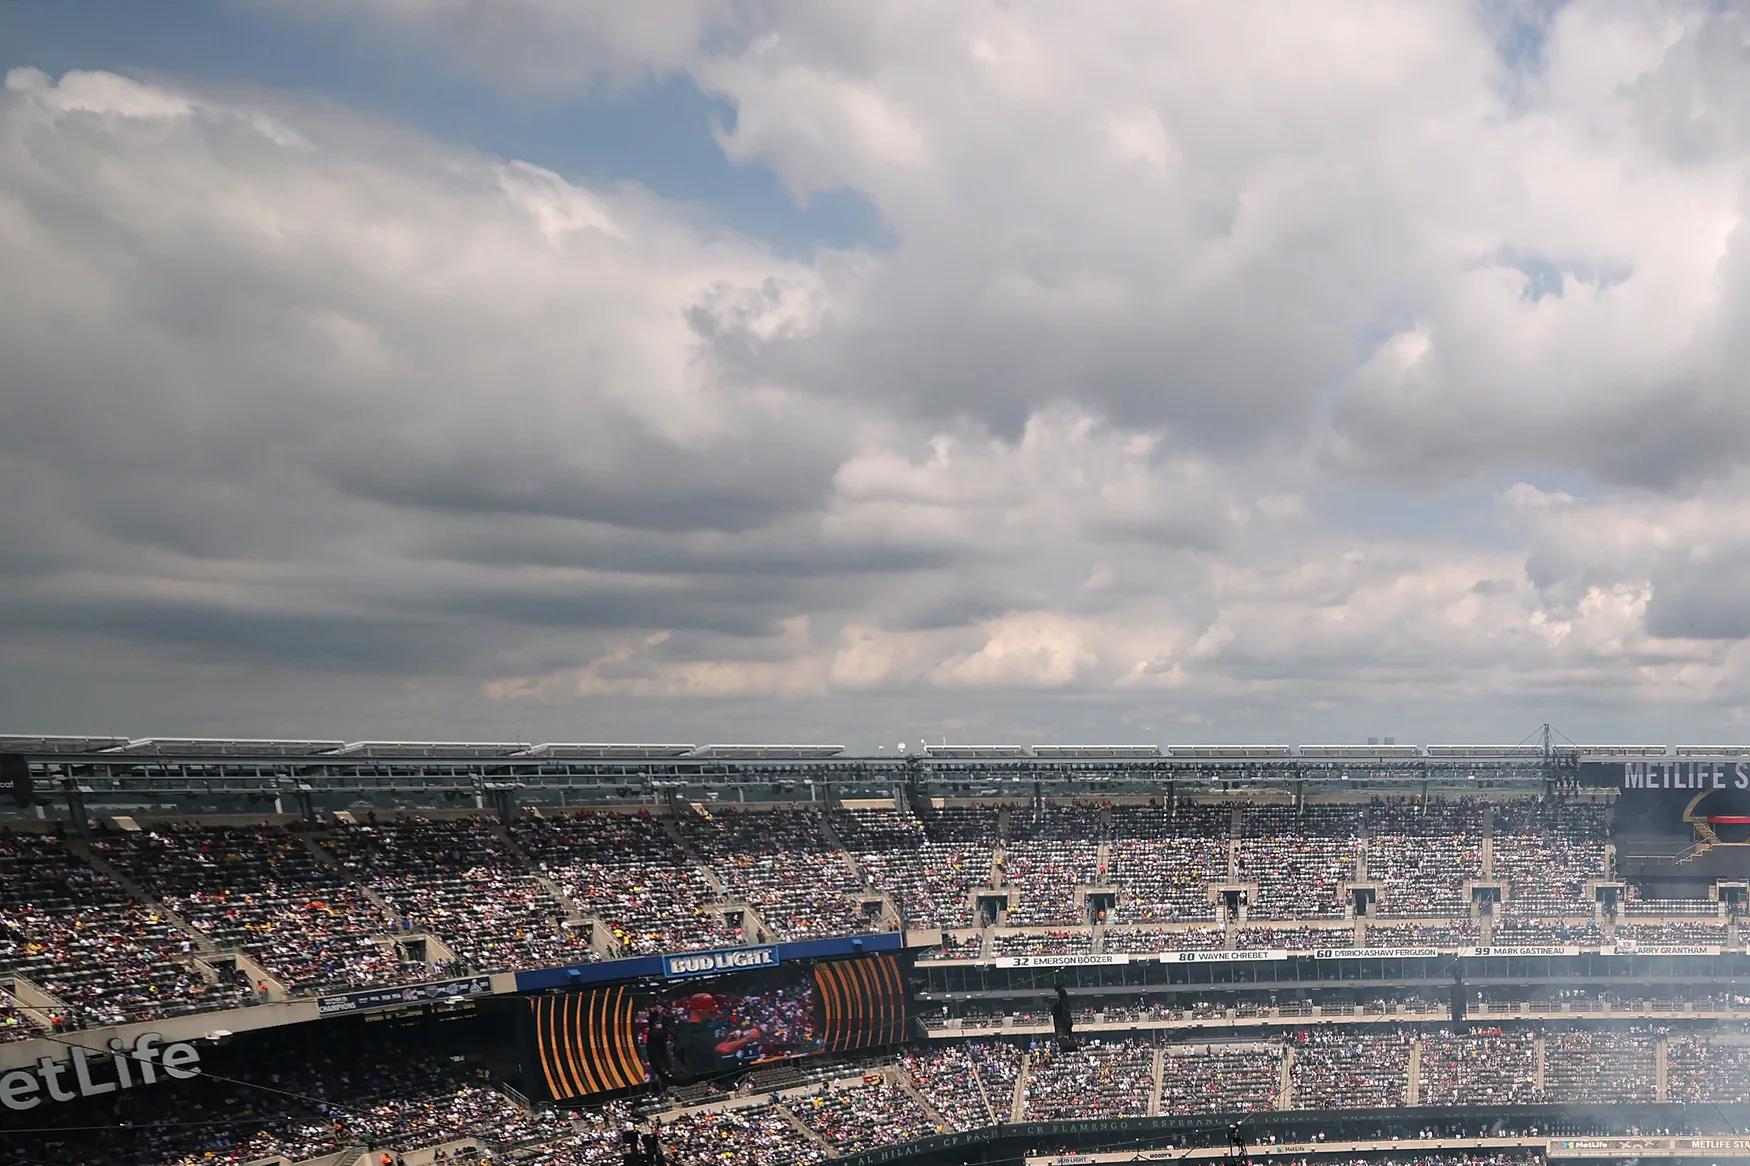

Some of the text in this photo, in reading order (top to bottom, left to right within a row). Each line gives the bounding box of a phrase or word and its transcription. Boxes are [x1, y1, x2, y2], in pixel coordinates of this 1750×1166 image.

[1624, 762, 1726, 789] METLIFE
[1316, 950, 1332, 958] 60
[1474, 947, 1490, 956] 99
[669, 948, 774, 974] BUD LIGHT
[1013, 956, 1112, 966] 32 EMERSON BOOZER
[1179, 953, 1195, 961] 80
[1198, 952, 1230, 960] WAYNE
[1053, 1122, 1128, 1132] FLAMENGO
[1575, 1141, 1608, 1149] MetLife
[1691, 1140, 1731, 1149] METLIFE
[858, 1145, 921, 1166] AL HILAL
